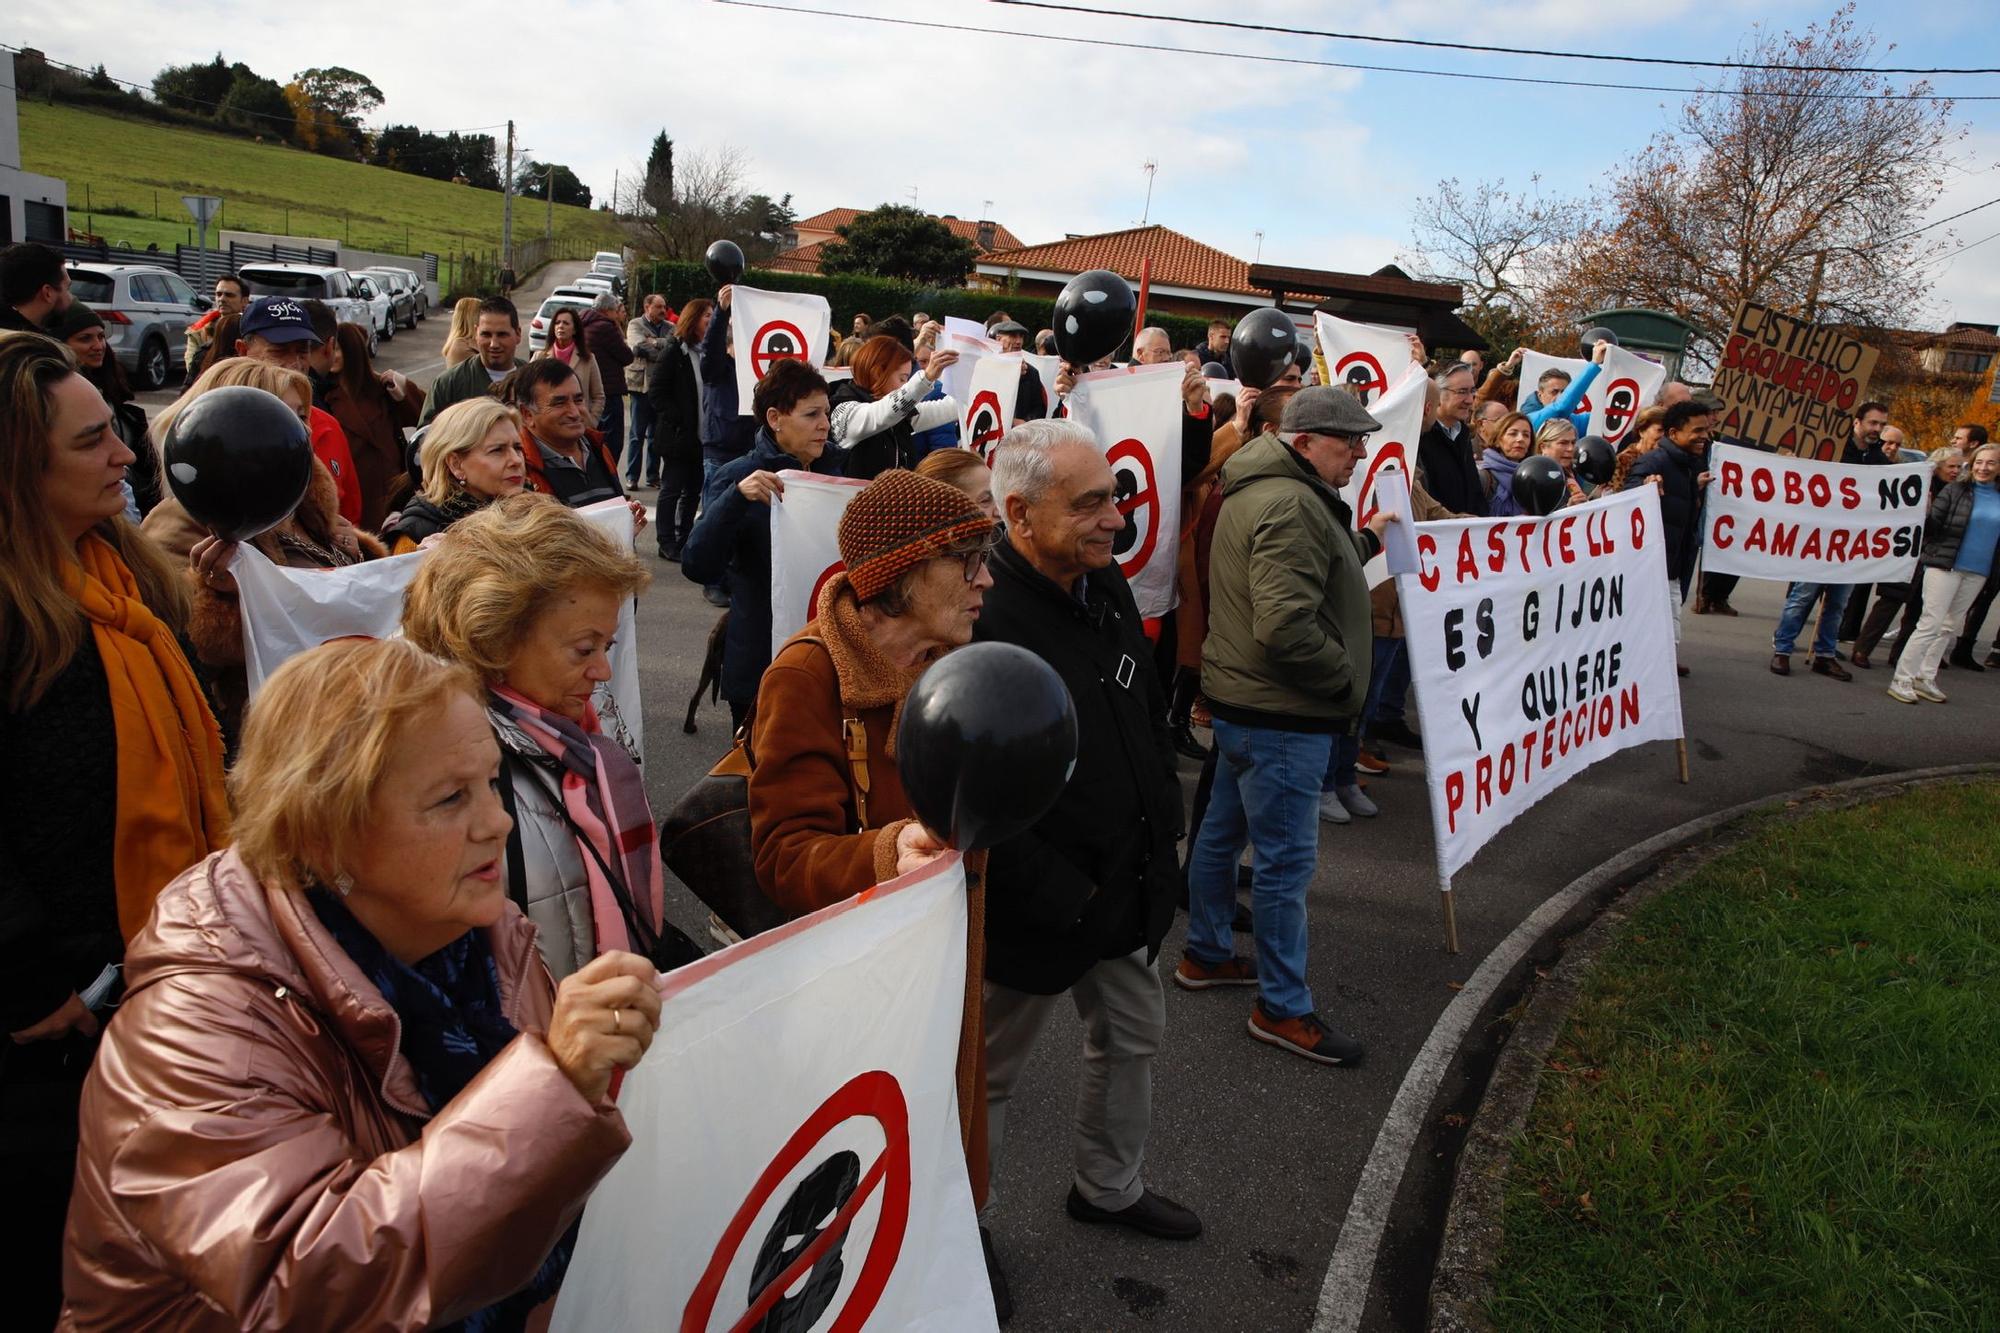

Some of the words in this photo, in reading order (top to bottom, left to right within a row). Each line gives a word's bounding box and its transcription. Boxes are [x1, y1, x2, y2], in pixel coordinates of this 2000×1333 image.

[1722, 335, 1859, 410] SAQUEADO
[1736, 301, 1863, 375] CASTIELLO
[1712, 368, 1853, 439] AYUNTAMIENTO
[1713, 406, 1836, 461] ALLADO
[1721, 460, 1861, 510] ROBOS
[1878, 474, 1922, 510] NO
[1417, 507, 1645, 592] CASTIELLO
[1444, 597, 1495, 672] ES
[1522, 573, 1624, 642] GIJON
[1461, 692, 1481, 751] Y
[1521, 641, 1622, 722] QUIERE
[1445, 681, 1640, 834] PROTECCION
